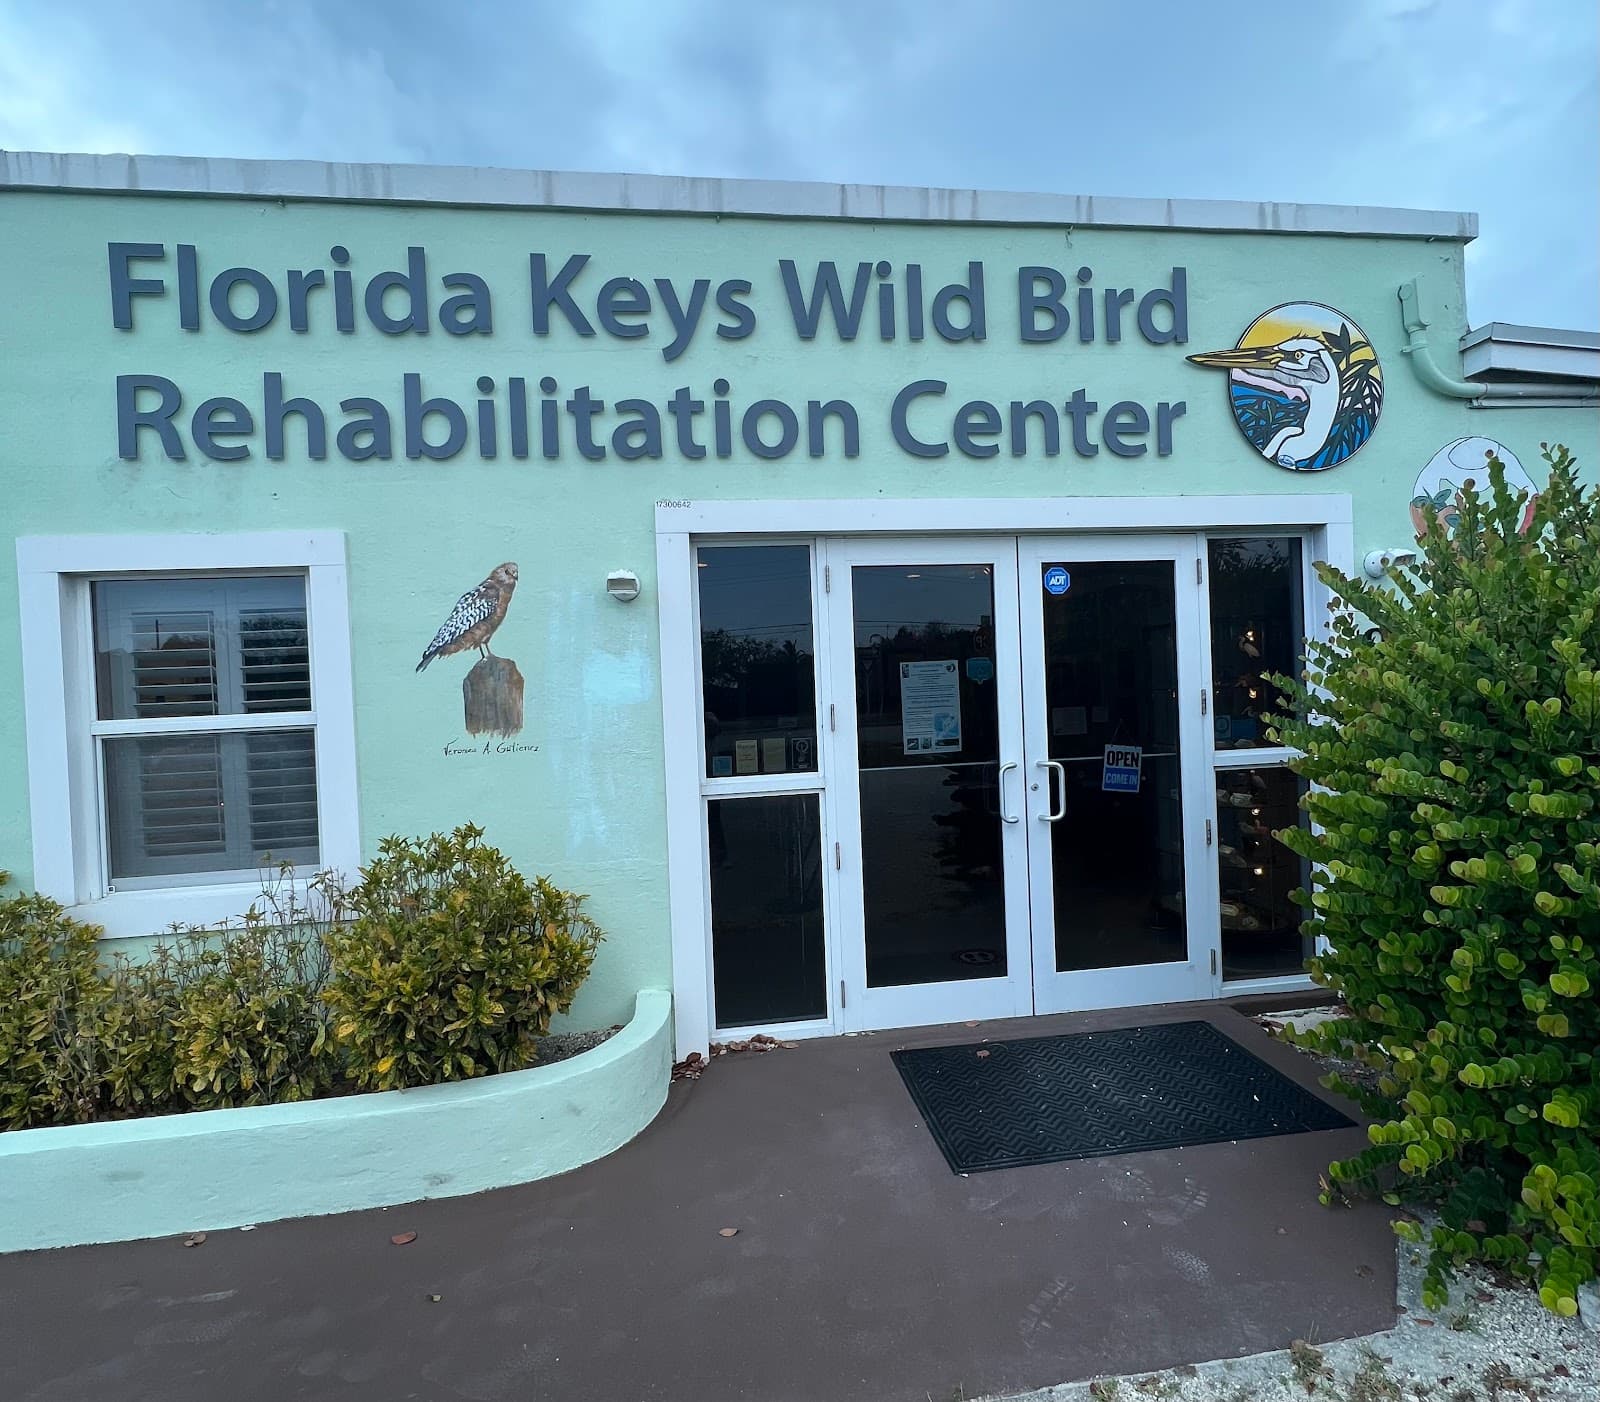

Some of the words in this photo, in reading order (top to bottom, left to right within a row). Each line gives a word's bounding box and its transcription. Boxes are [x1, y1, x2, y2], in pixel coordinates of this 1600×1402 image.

[108, 242, 493, 336] Florida
[530, 253, 756, 362] Keys
[779, 260, 986, 342] Wild
[1018, 266, 1188, 344] Bird
[117, 372, 859, 461] Rehabilitation
[891, 380, 1186, 458] Center
[1049, 576, 1065, 585] ADT
[1106, 751, 1139, 767] OPEN
[1106, 773, 1128, 784] COME
[1129, 774, 1137, 784] IN
